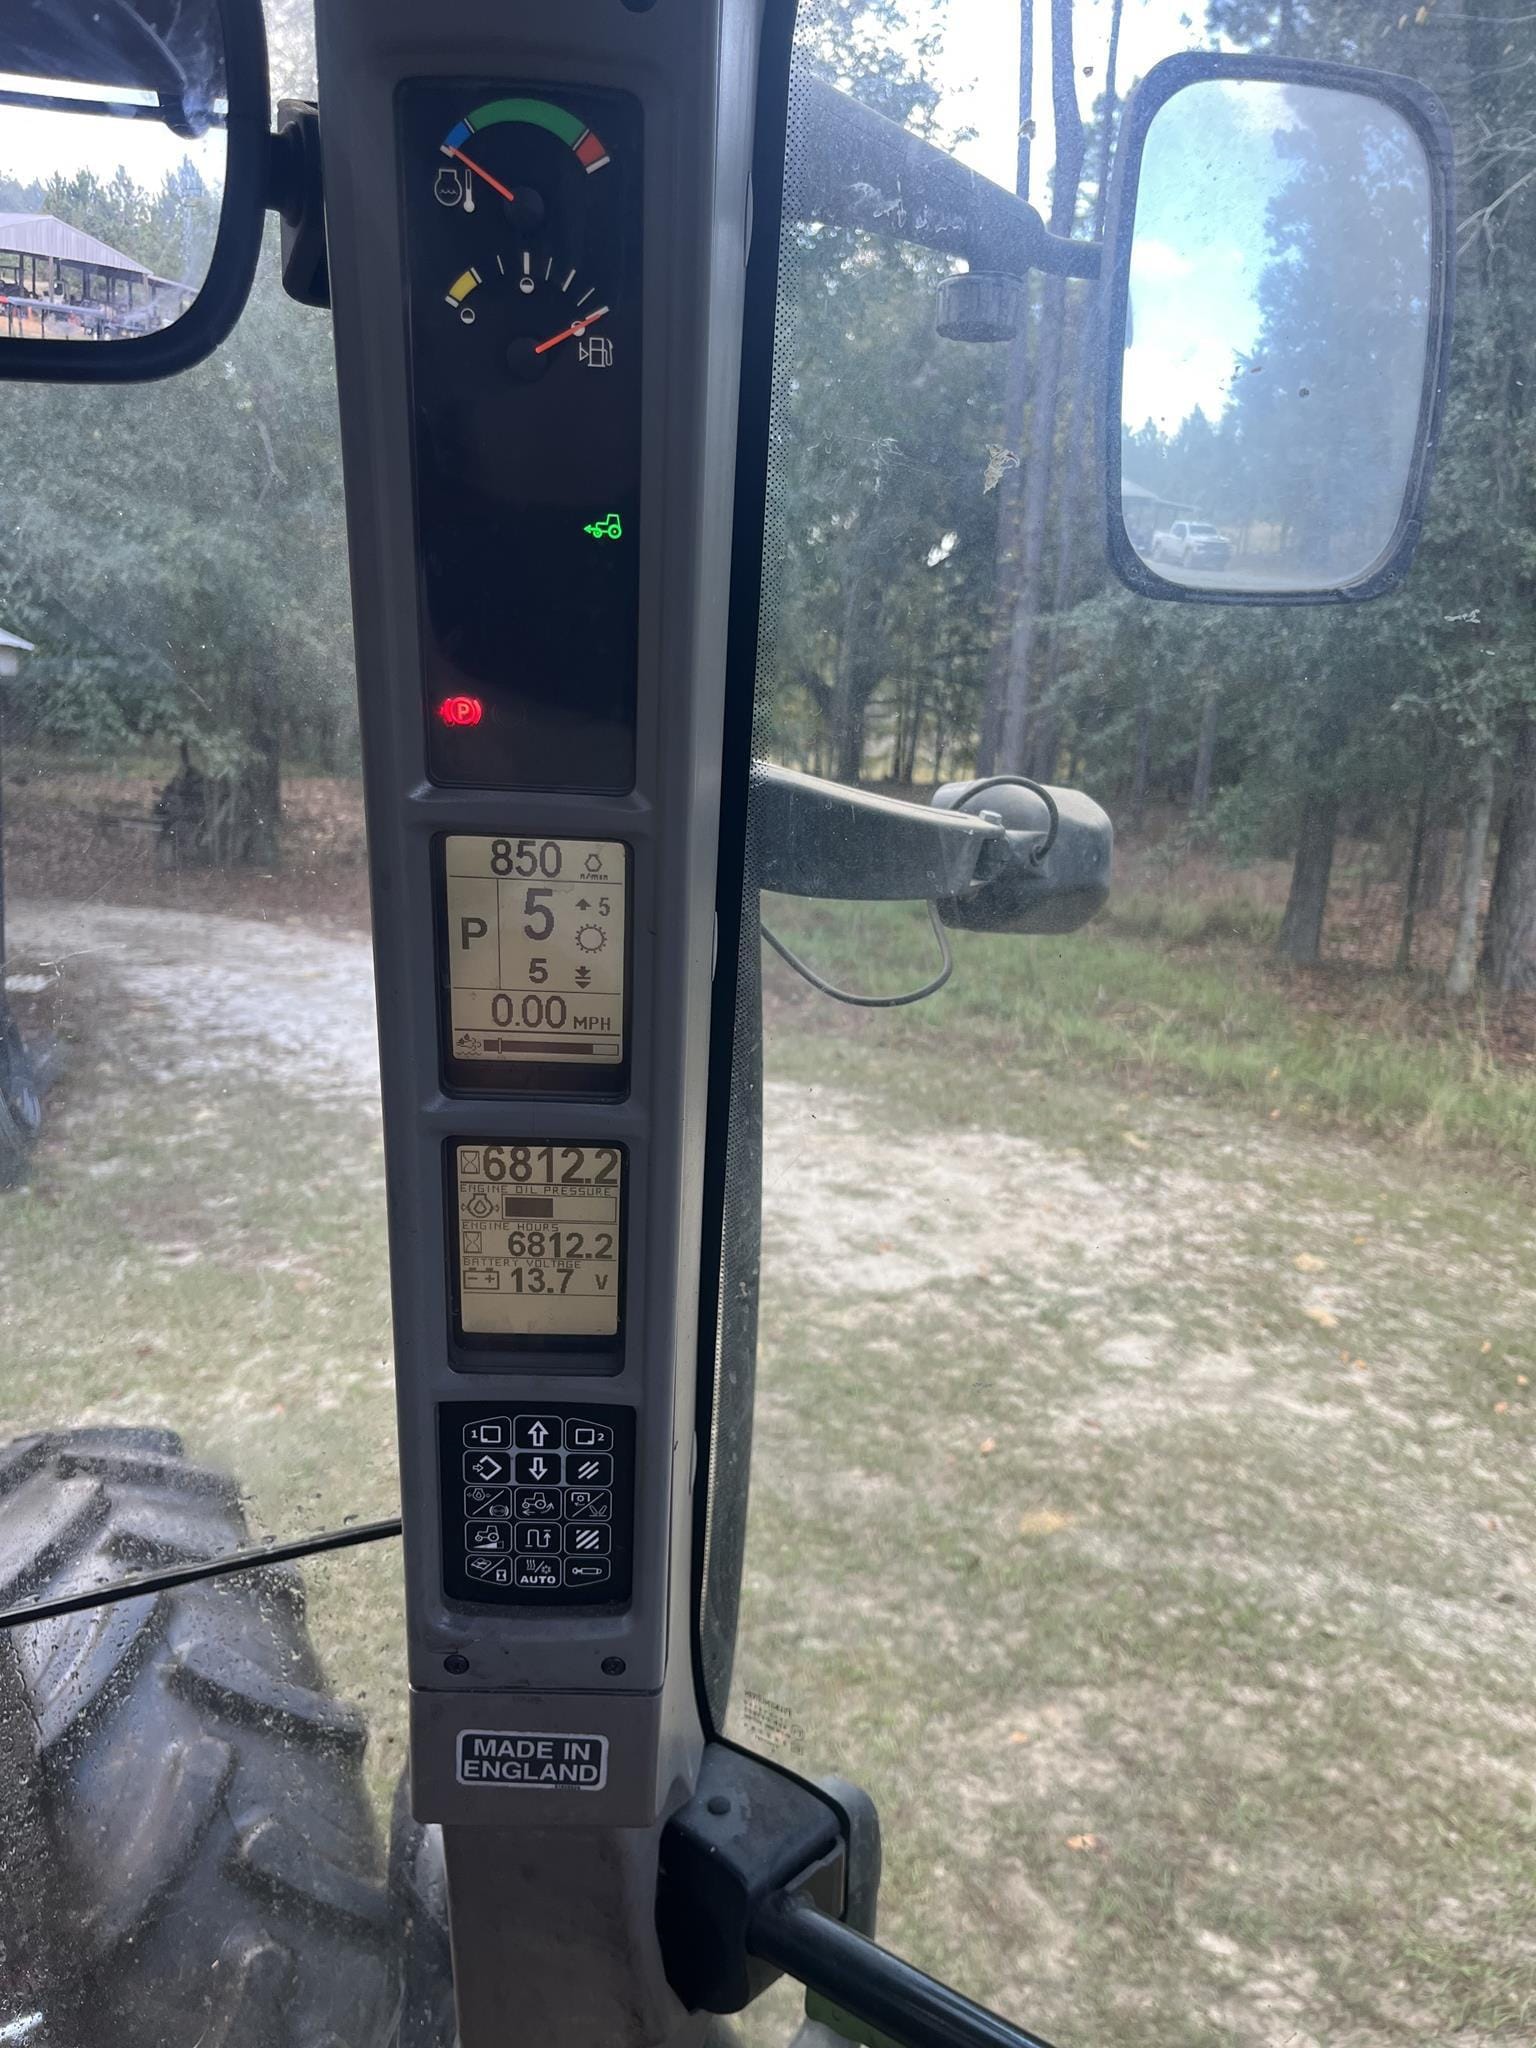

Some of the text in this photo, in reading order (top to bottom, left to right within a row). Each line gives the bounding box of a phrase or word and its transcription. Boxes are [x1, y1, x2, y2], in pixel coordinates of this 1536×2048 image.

[490, 839, 562, 878] 850
[523, 887, 555, 941] 5
[598, 897, 611, 917] 5
[460, 916, 488, 950] P
[528, 958, 549, 984] 5
[491, 993, 611, 1031] 0.00 MPH
[483, 1145, 618, 1185] 6812.2
[460, 1184, 611, 1197] ENGINE OIL PRESSURE
[462, 1221, 559, 1232] ENGINE HOURS
[507, 1231, 613, 1259] 6812.2
[463, 1257, 582, 1269] BATTERY VOLTAGE
[510, 1267, 608, 1294] 13.7 V
[471, 1429, 478, 1439] 1
[597, 1433, 605, 1442] 2
[520, 1575, 556, 1584] AUTO
[473, 1738, 591, 1761] MADE IN
[463, 1759, 598, 1782] ENGLAND
